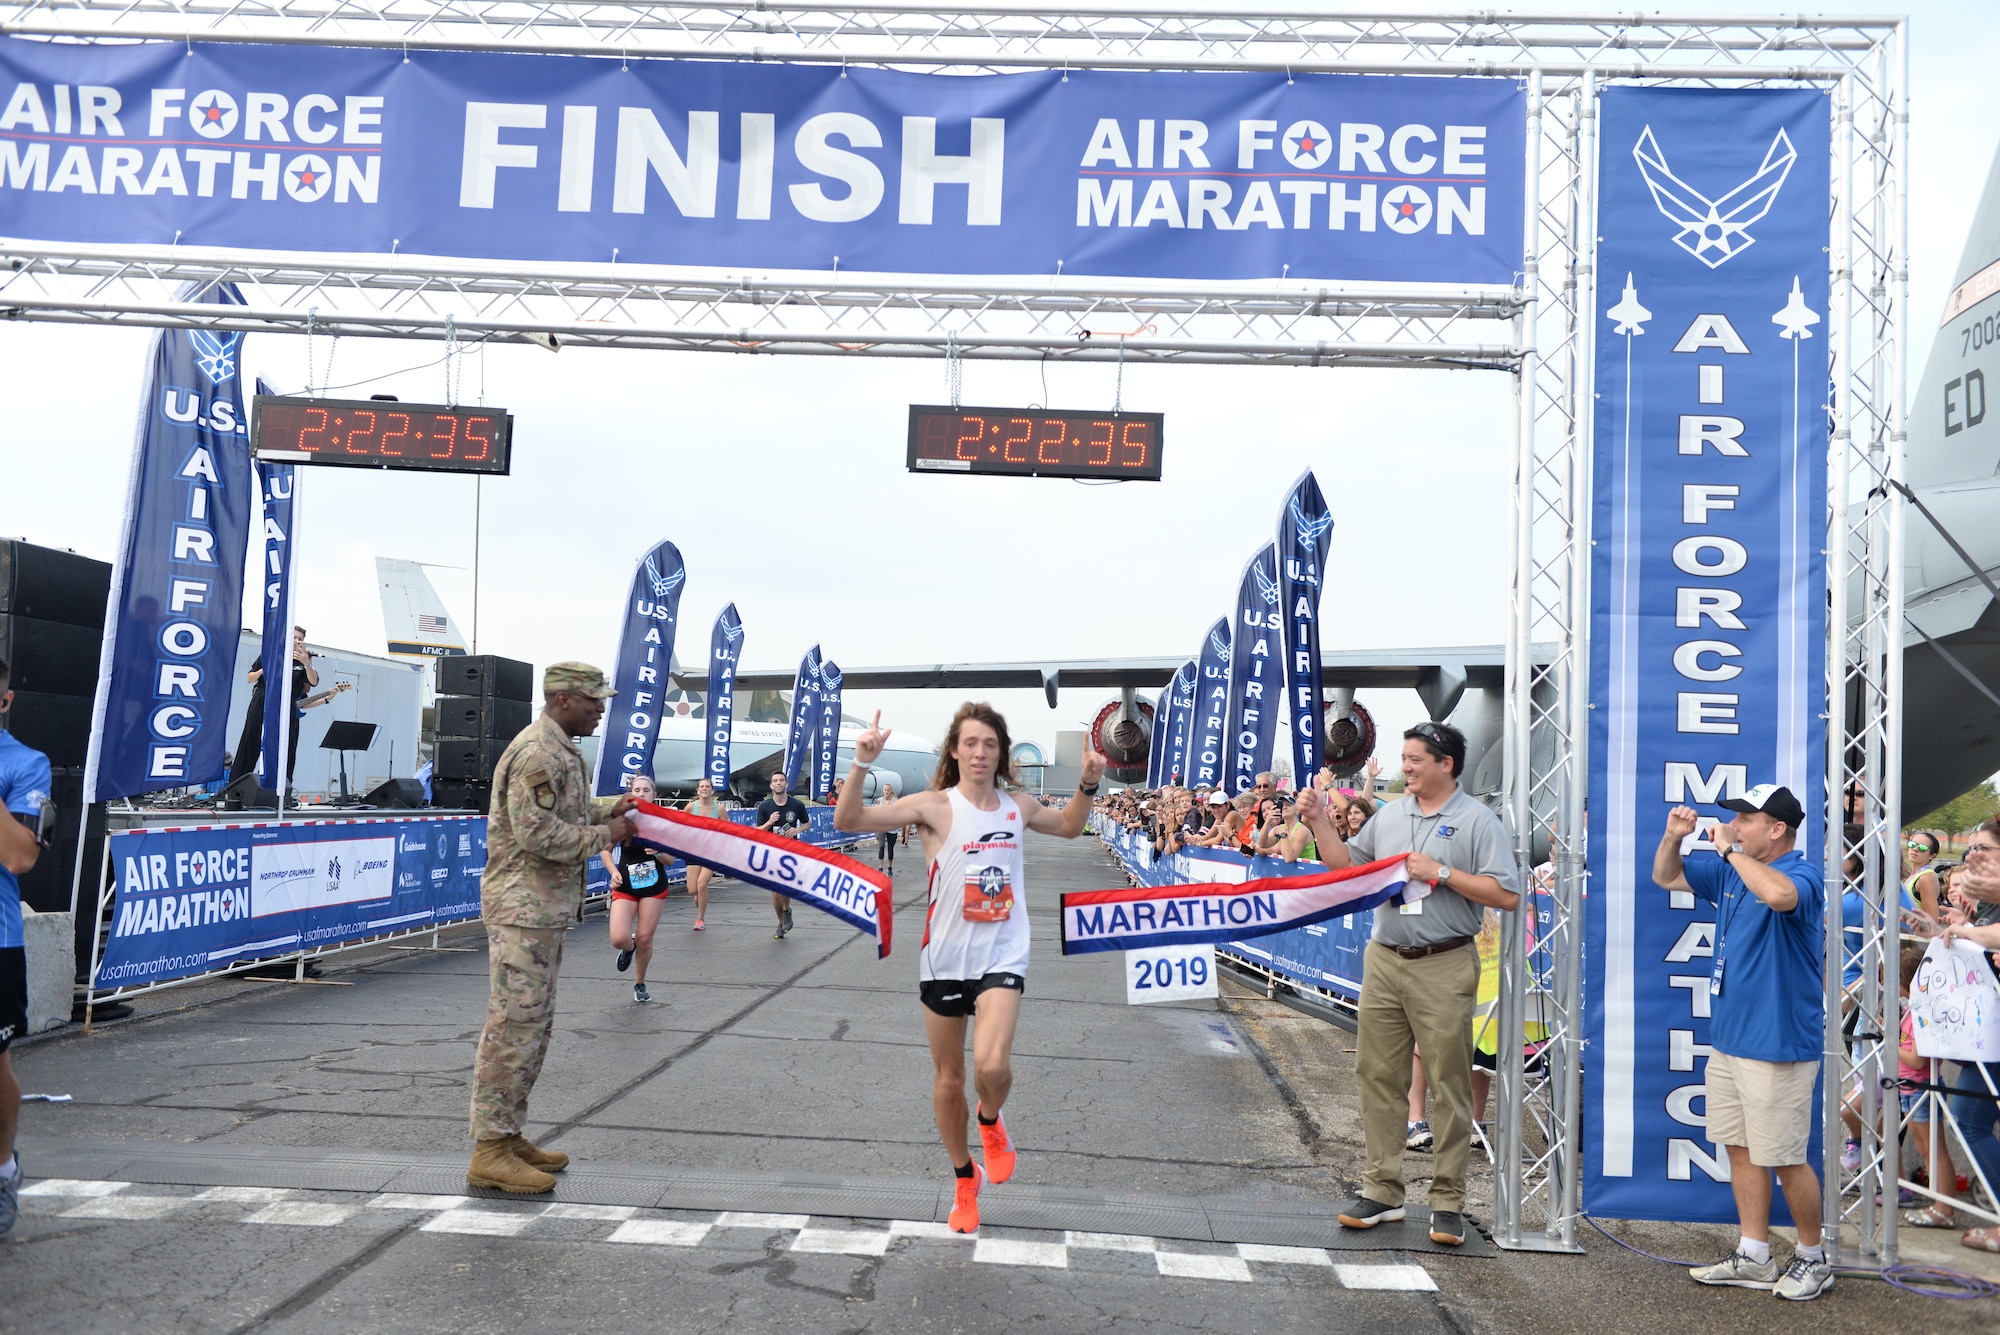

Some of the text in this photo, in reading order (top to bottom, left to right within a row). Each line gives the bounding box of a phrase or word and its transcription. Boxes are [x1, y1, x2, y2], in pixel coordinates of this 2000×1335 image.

[0, 82, 385, 145] AIR FORCE
[459, 101, 1005, 228] FINISH
[1080, 118, 1487, 175] AIR FORCE
[0, 139, 382, 203] MARATHON
[1076, 179, 1486, 236] MARATHON
[1976, 267, 2000, 297] ED
[1670, 312, 1754, 458] AIR
[1944, 368, 1986, 438] ED
[164, 390, 246, 434] U.S.
[1286, 559, 1319, 587] U.S
[150, 447, 218, 778] AIR FORCE
[636, 600, 674, 622] U.S.
[1243, 608, 1281, 630] U.S
[1670, 483, 1751, 736] FORCE
[421, 646, 444, 656] AFMC
[638, 627, 662, 685] AIR
[1295, 596, 1313, 674] AIR
[1205, 665, 1230, 679] U.S
[711, 667, 732, 788] AIR FORCE
[1174, 712, 1185, 747] AIR
[1207, 686, 1226, 730] AIR
[1236, 638, 1270, 794] AIR FORC
[820, 706, 833, 793] AIR FORCE
[124, 848, 249, 893] AIR FORCE
[260, 868, 316, 881] NORTHROP GRUMMAN
[326, 881, 340, 891] USAA
[362, 860, 389, 870] BOEING
[748, 845, 803, 886] U.S.
[811, 867, 854, 905] AIR
[115, 886, 249, 937] MARATHON
[303, 921, 367, 942] usafmarathon.com
[1076, 893, 1277, 937] MARATHON
[100, 951, 208, 981] usafmarathon.com
[1134, 956, 1208, 989] 2019
[1273, 954, 1322, 979] usafmarathon.com
